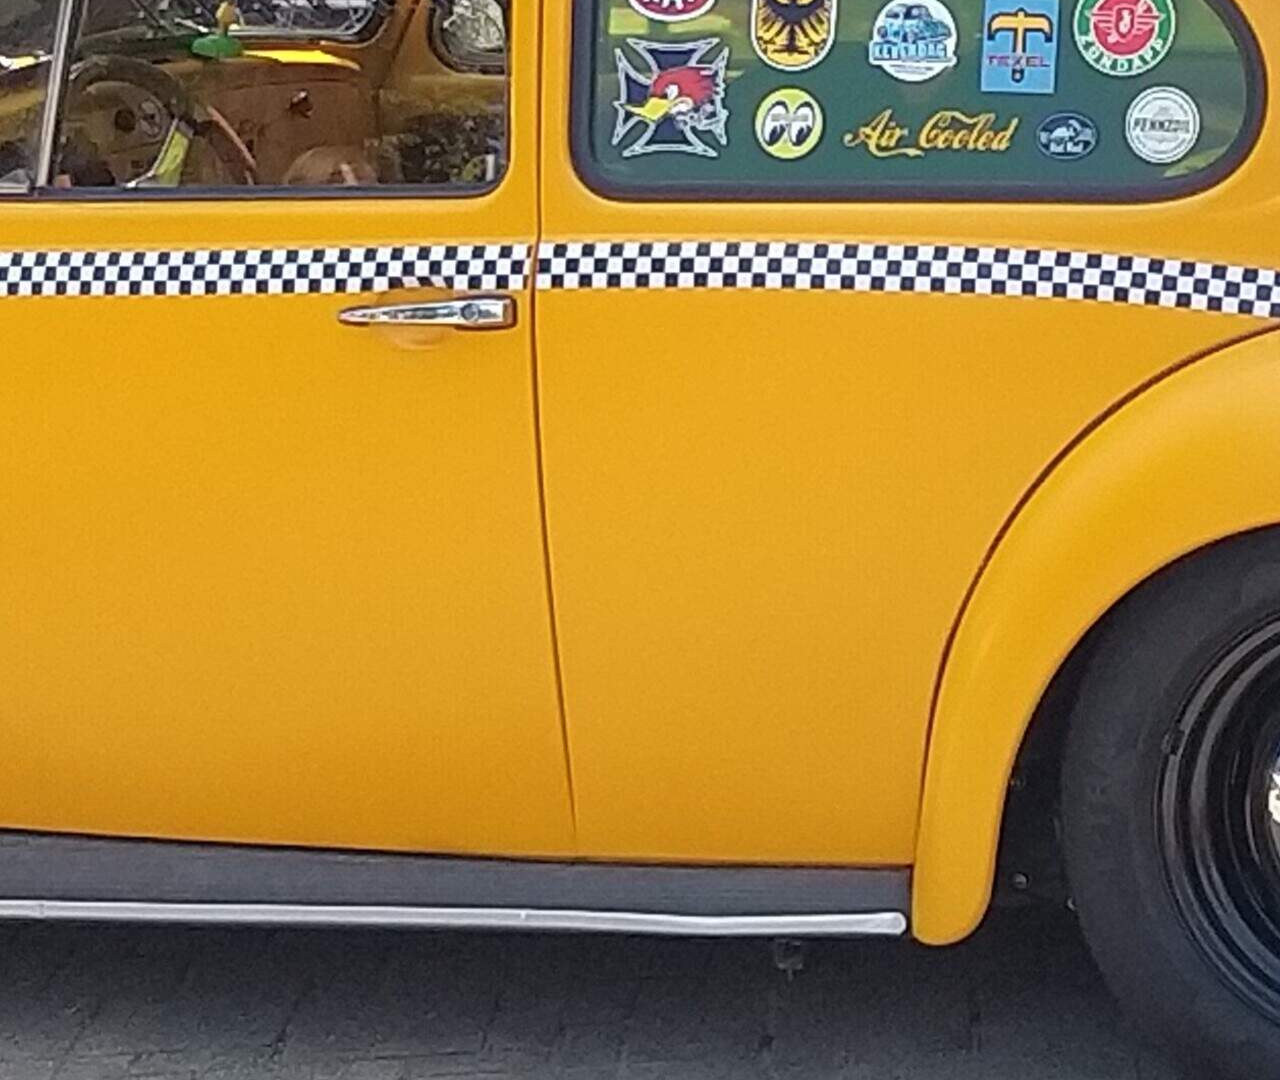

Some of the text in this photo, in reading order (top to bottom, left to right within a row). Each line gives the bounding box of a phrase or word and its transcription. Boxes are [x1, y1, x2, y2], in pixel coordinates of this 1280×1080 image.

[987, 55, 1051, 69] TEXEL
[842, 108, 1020, 157] Air Cooled
